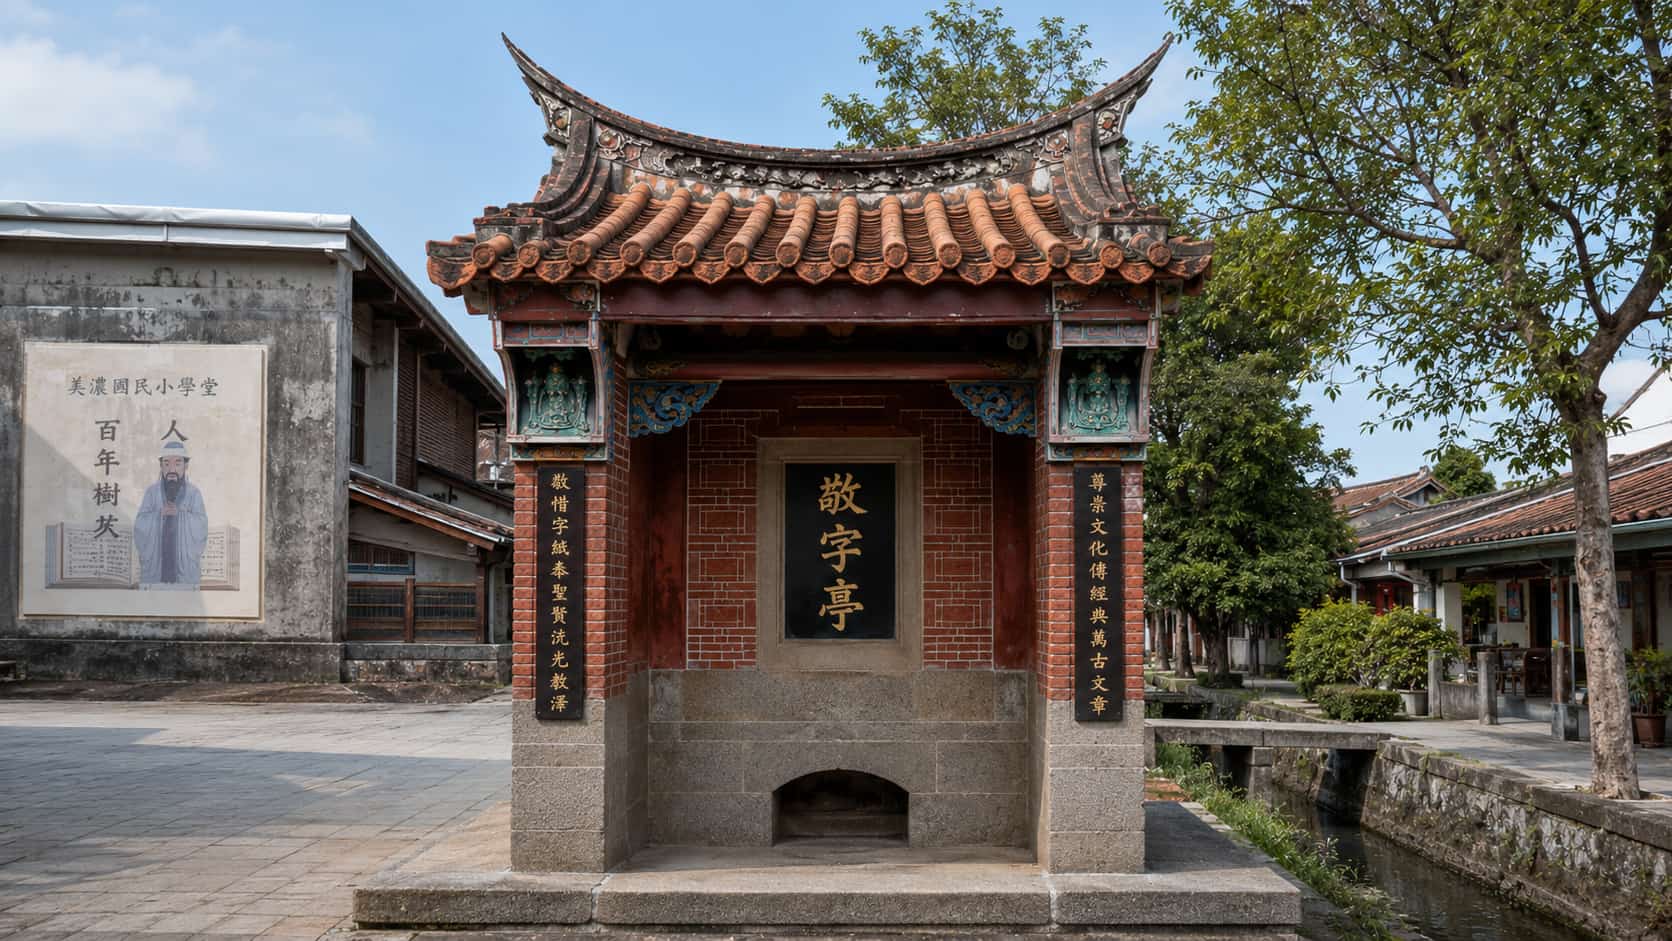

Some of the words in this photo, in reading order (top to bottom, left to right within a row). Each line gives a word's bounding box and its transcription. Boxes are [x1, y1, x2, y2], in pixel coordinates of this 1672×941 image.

[67, 376, 220, 397] 美濃國民小學堂
[161, 419, 188, 442] 人
[818, 472, 868, 632] 敬字亭
